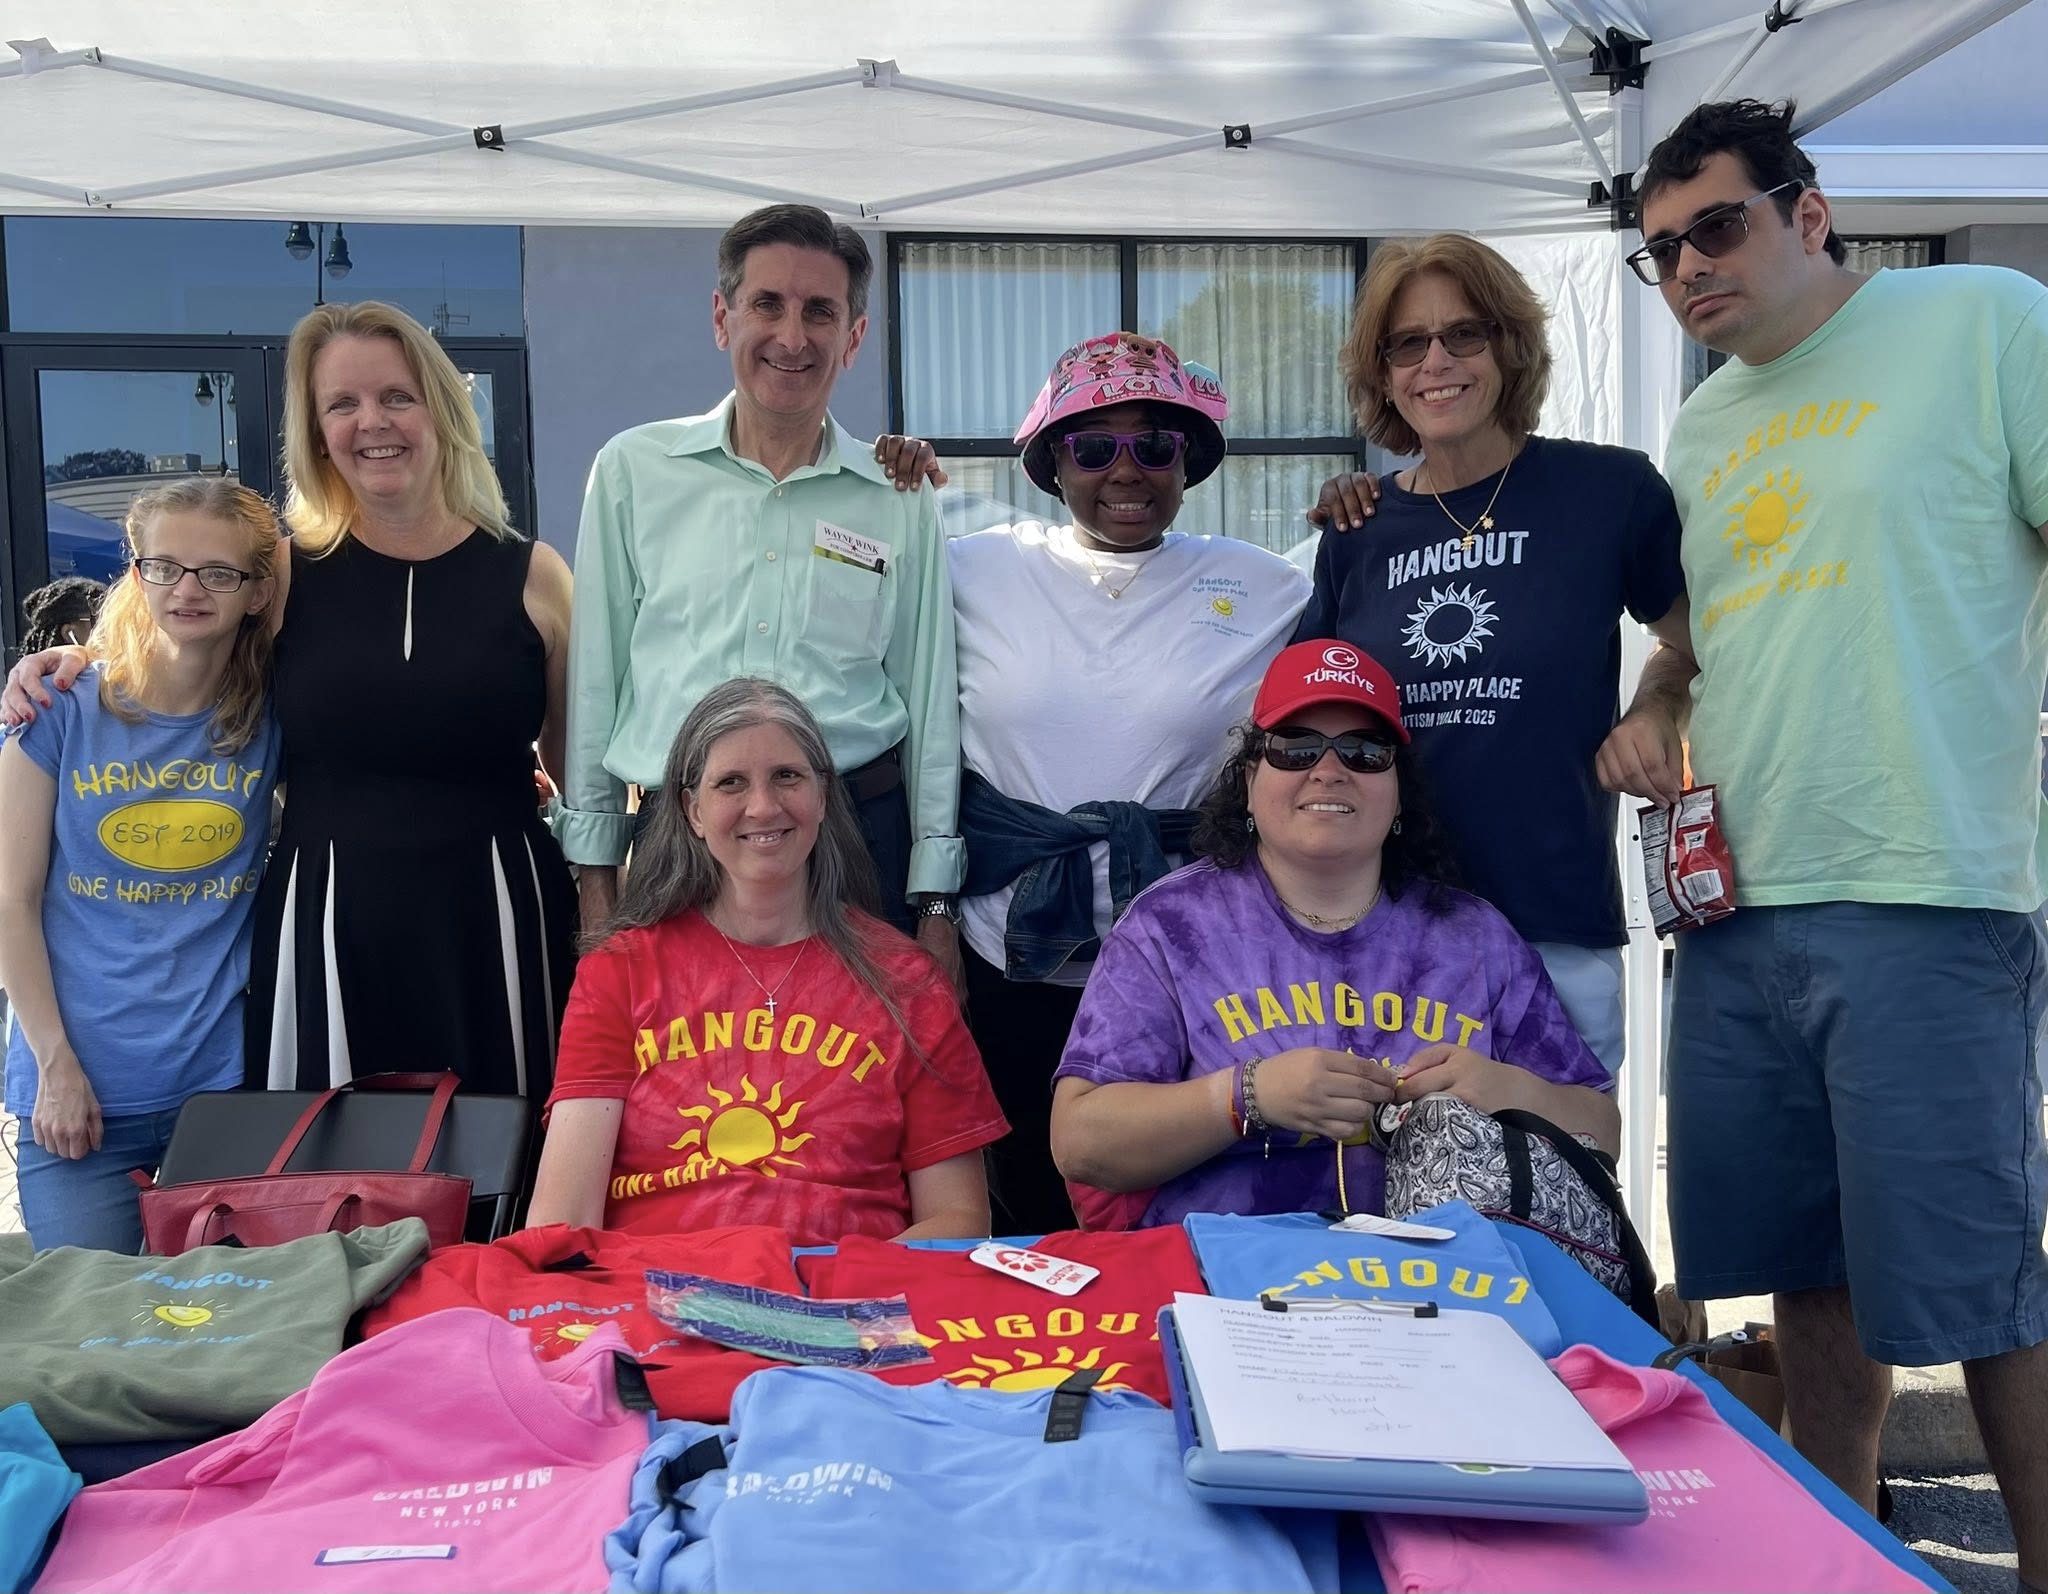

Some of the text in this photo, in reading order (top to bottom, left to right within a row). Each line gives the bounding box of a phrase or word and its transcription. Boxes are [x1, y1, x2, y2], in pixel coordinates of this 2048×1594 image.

[823, 527, 879, 555] WAYNE WINK
[1387, 530, 1530, 590] HANGOUT
[1303, 667, 1376, 695] TÜRKİYE
[1406, 679, 1464, 704] HAPPY
[1465, 676, 1522, 700] PLACE
[1399, 712, 1435, 729] UTISM
[1464, 709, 1496, 725] 2025
[73, 758, 263, 800] HANGOUT
[113, 821, 236, 847] EST. 2019
[68, 870, 257, 905] ONE HAPPY PLAE
[1212, 981, 1484, 1048] HANGOUT
[634, 1009, 886, 1083] HANGOUT
[612, 1158, 731, 1199] ONE HAP
[135, 1271, 275, 1290] HANGOUT
[1256, 1257, 1530, 1304] NGOUT
[508, 1301, 635, 1321] HANGOUT
[917, 1307, 1160, 1350] NGOU
[400, 1497, 519, 1519] NEW YORK
